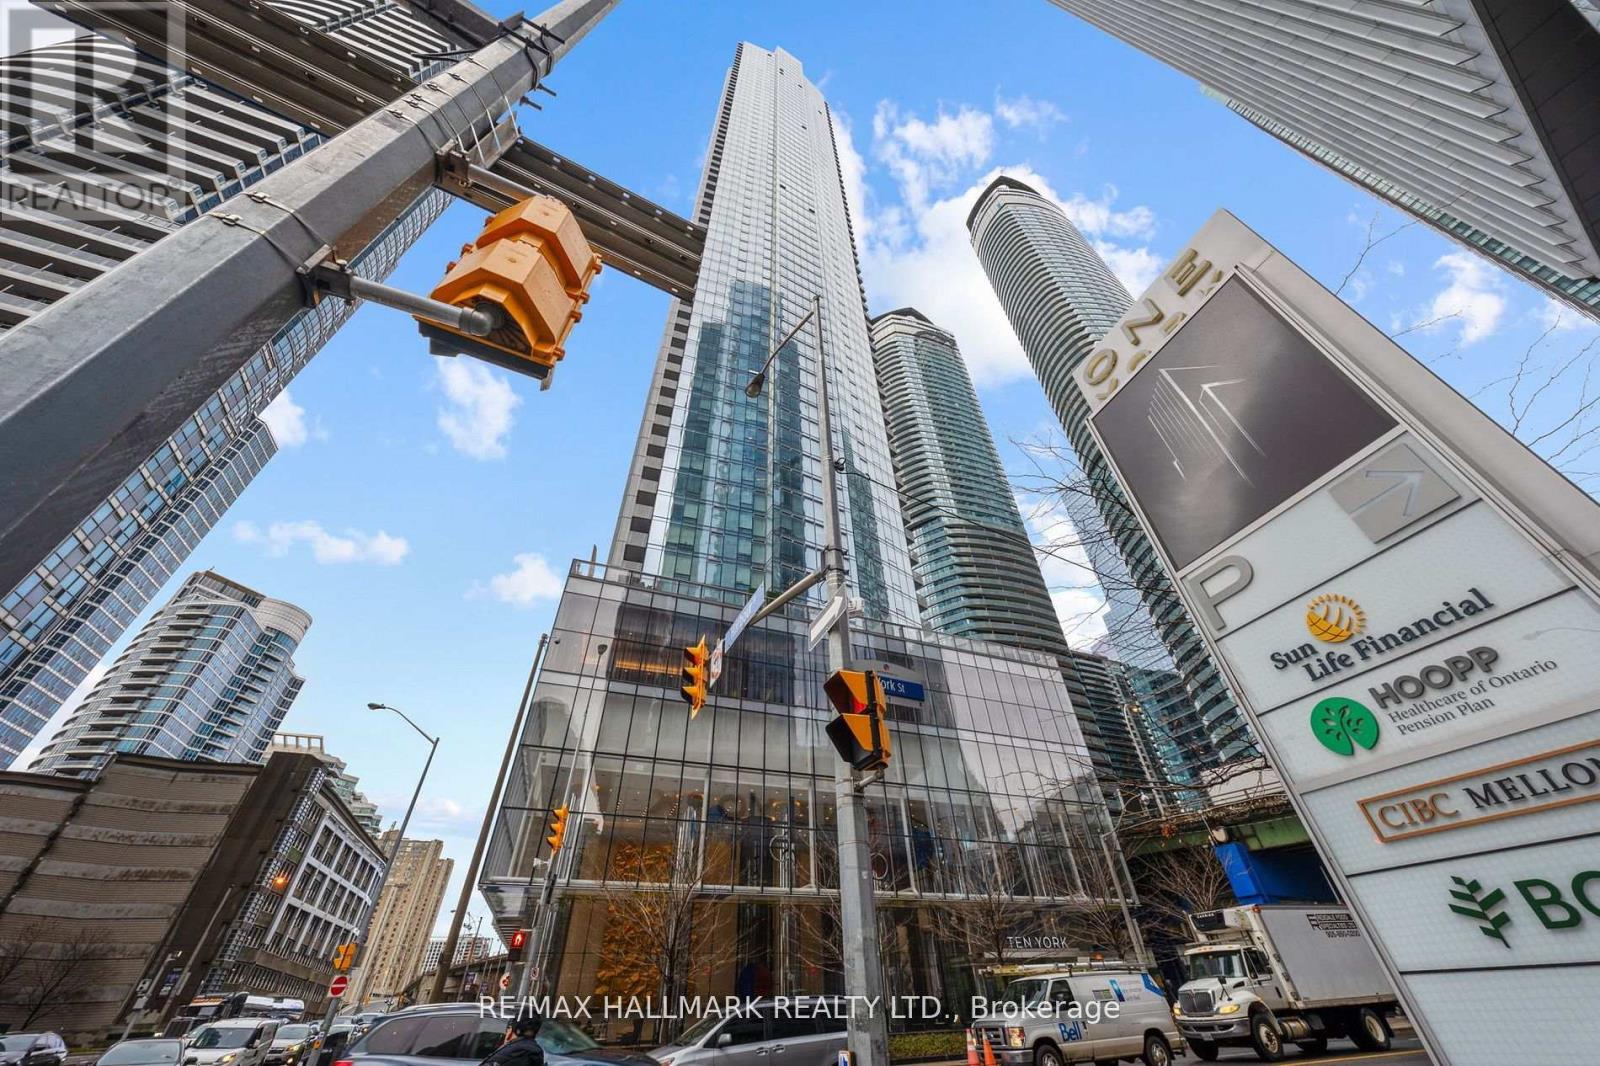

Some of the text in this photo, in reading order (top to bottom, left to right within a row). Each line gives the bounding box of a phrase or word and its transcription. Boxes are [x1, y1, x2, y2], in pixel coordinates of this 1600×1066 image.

[1083, 248, 1212, 386] ONE
[1188, 555, 1254, 631] P
[1302, 587, 1495, 682] Life Financial
[1270, 642, 1319, 670] Sun
[879, 676, 906, 694] ork St
[1368, 646, 1499, 710] HOOPP
[1388, 660, 1558, 723] Healthcare of Ontario
[1397, 698, 1496, 735] Pension Plan
[1378, 793, 1460, 829] CIBC
[1006, 936, 1069, 949] TEN YORK
[1059, 1020, 1082, 1042] Bell
